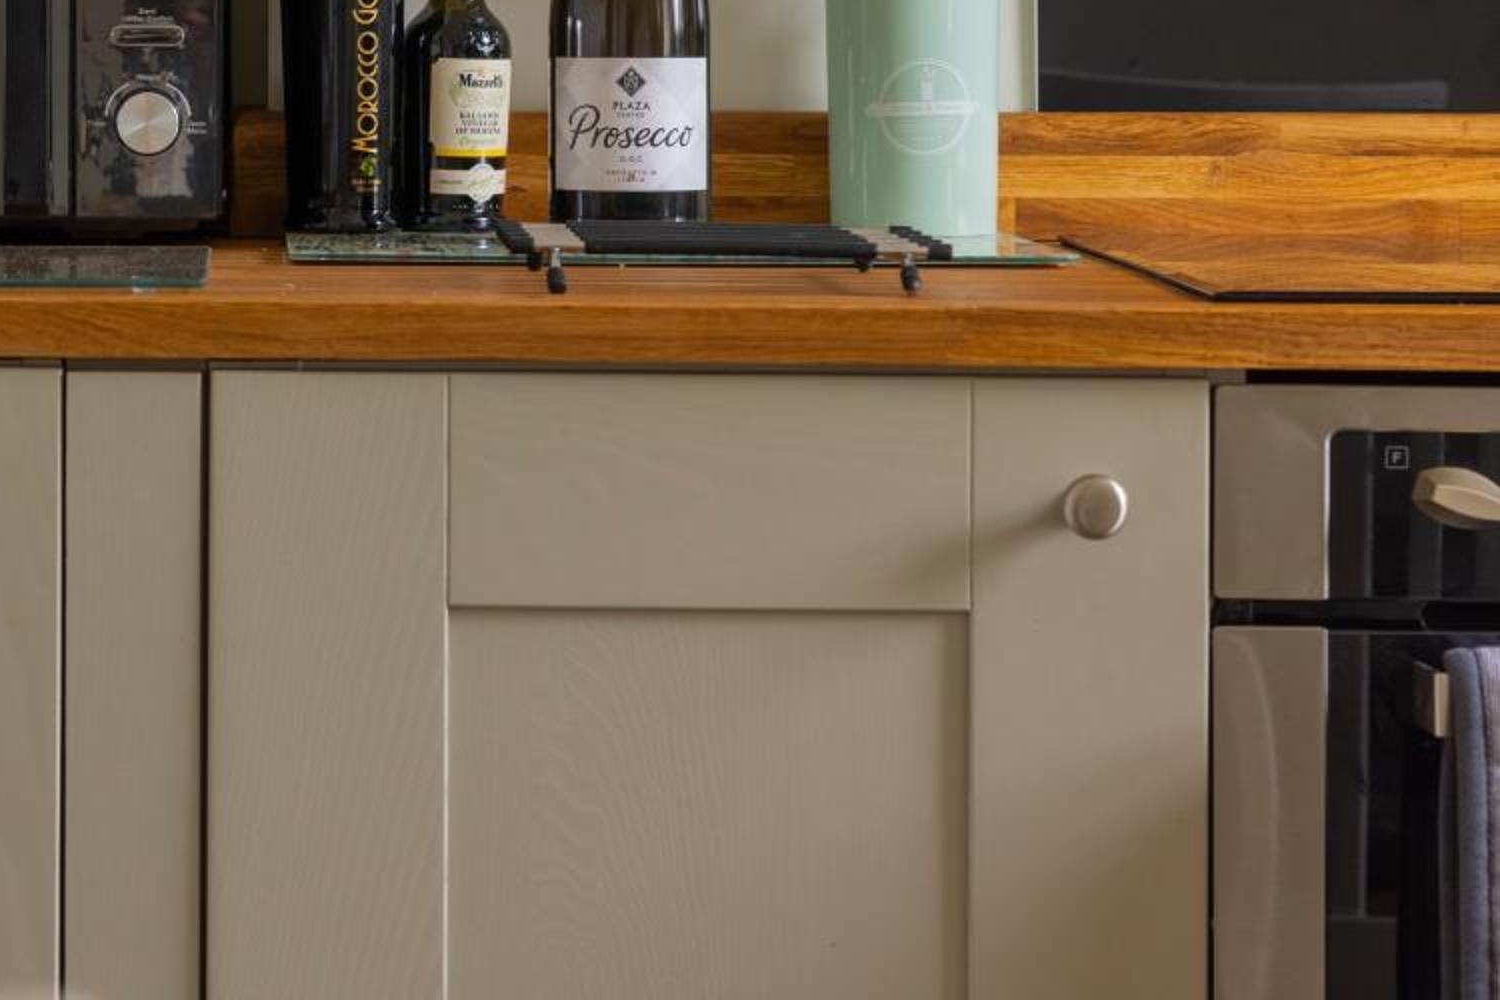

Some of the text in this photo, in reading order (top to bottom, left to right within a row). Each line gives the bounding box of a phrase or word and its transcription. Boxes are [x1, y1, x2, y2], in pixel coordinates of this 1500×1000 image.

[351, 31, 379, 154] MOROCCO
[612, 101, 651, 111] PLAZA
[568, 104, 693, 151] Prosecco
[1391, 451, 1402, 464] F
